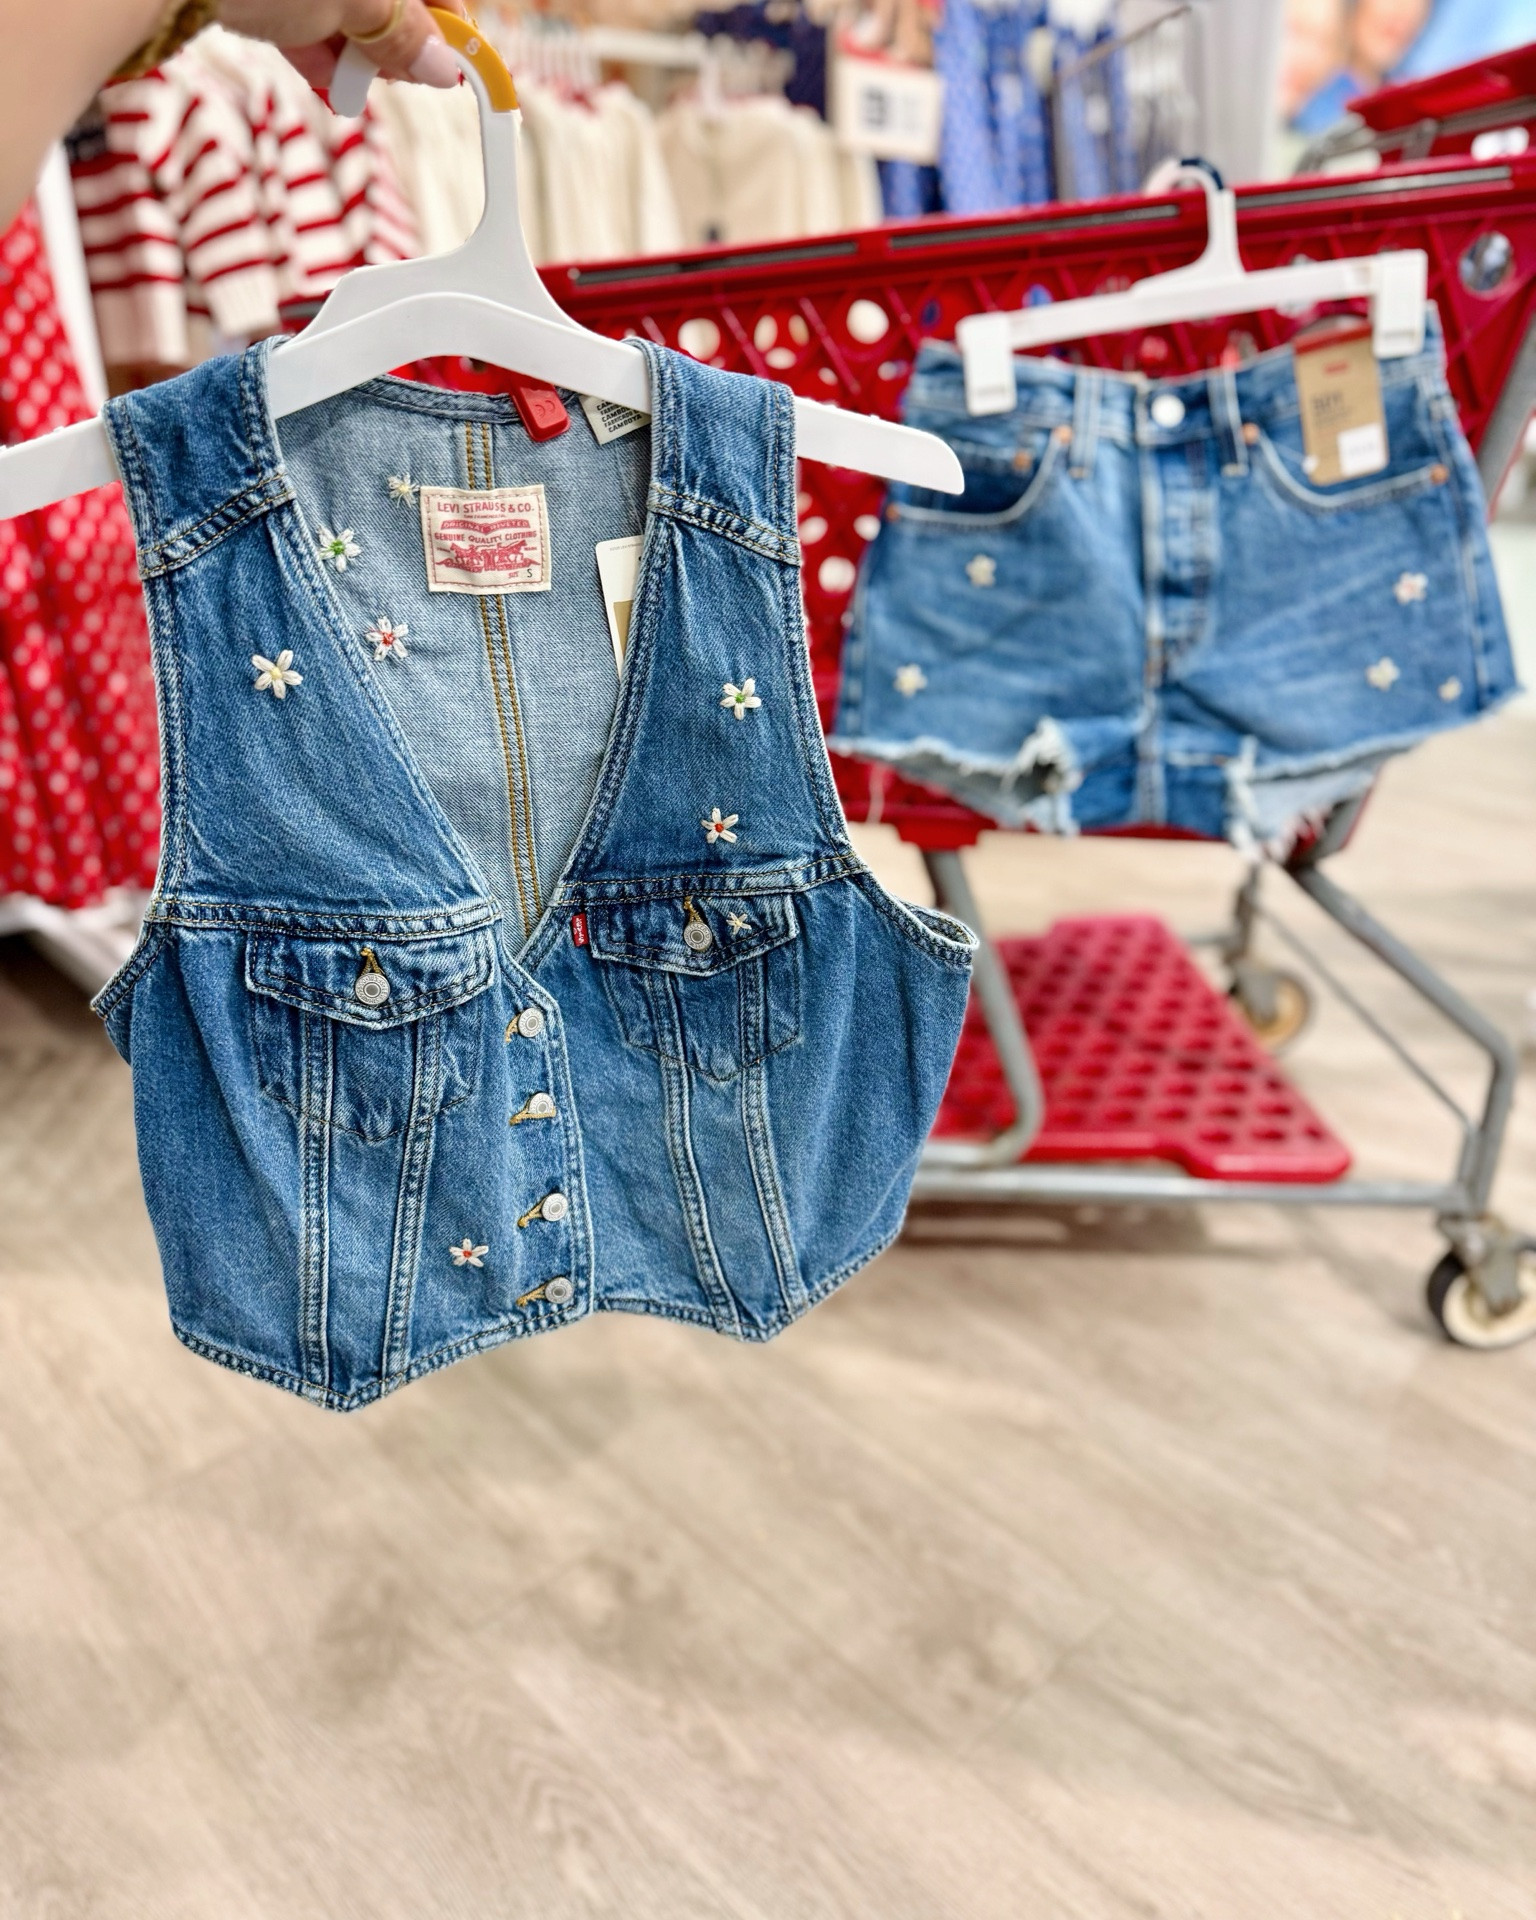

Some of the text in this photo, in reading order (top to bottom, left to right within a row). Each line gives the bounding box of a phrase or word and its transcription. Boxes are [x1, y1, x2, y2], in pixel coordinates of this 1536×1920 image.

[465, 37, 481, 56] S
[608, 413, 642, 432] CAMBOYA
[437, 501, 534, 513] LEVI STRAUSS & CO.
[434, 531, 537, 544] GENUINE QUALITY CLOTHING
[527, 569, 533, 578] S
